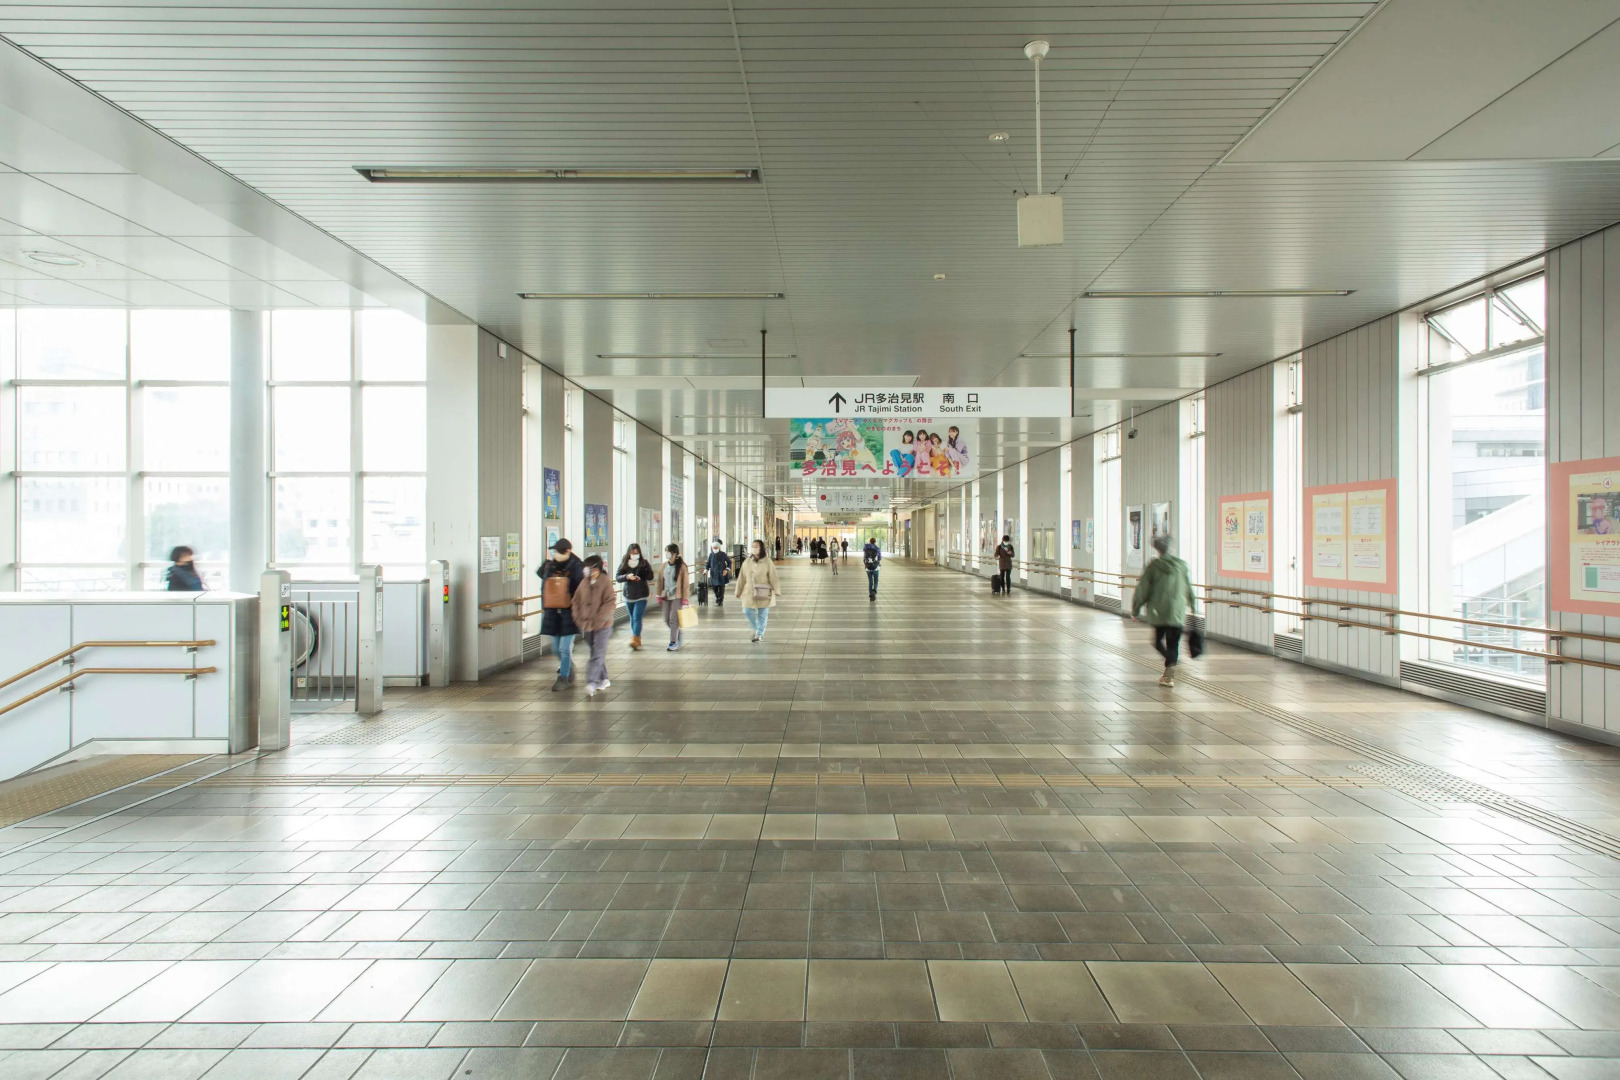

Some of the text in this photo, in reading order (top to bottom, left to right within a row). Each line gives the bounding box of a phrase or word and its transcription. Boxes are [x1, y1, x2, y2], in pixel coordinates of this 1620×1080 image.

[854, 392, 925, 404] JR多治見駅
[854, 405, 982, 415] JR Tajimi Station South Exit
